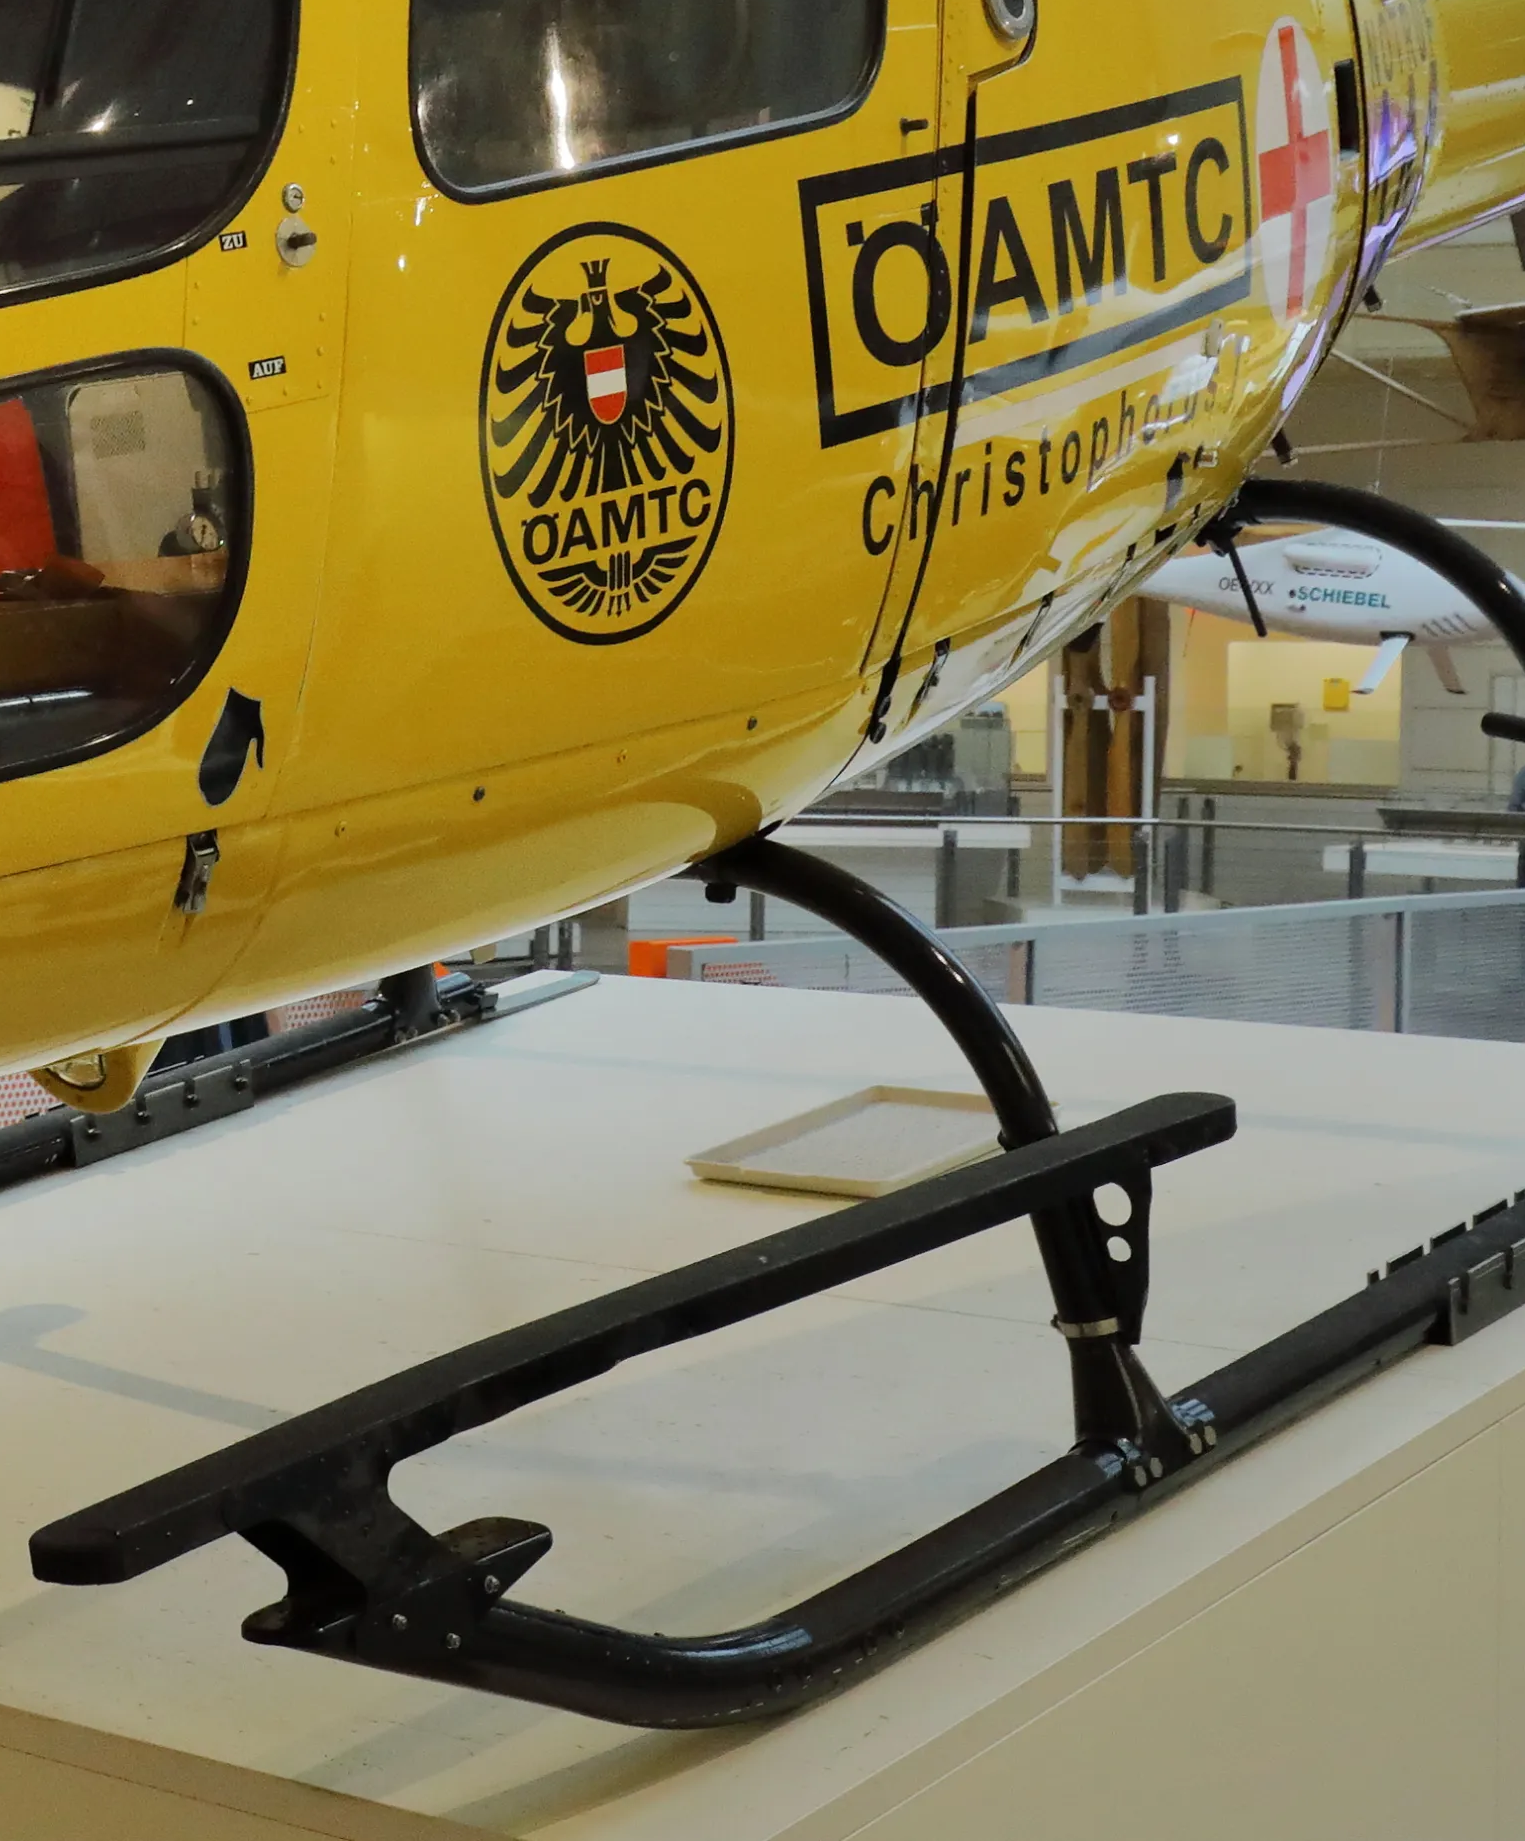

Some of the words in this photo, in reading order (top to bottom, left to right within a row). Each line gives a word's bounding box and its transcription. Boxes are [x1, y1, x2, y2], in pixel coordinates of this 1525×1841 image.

[221, 233, 244, 250] ZU
[846, 136, 1233, 368] ÖAMTC
[252, 358, 284, 378] AUF
[521, 478, 712, 565] ÖAMTC
[1298, 586, 1391, 609] SCHIEBEL
